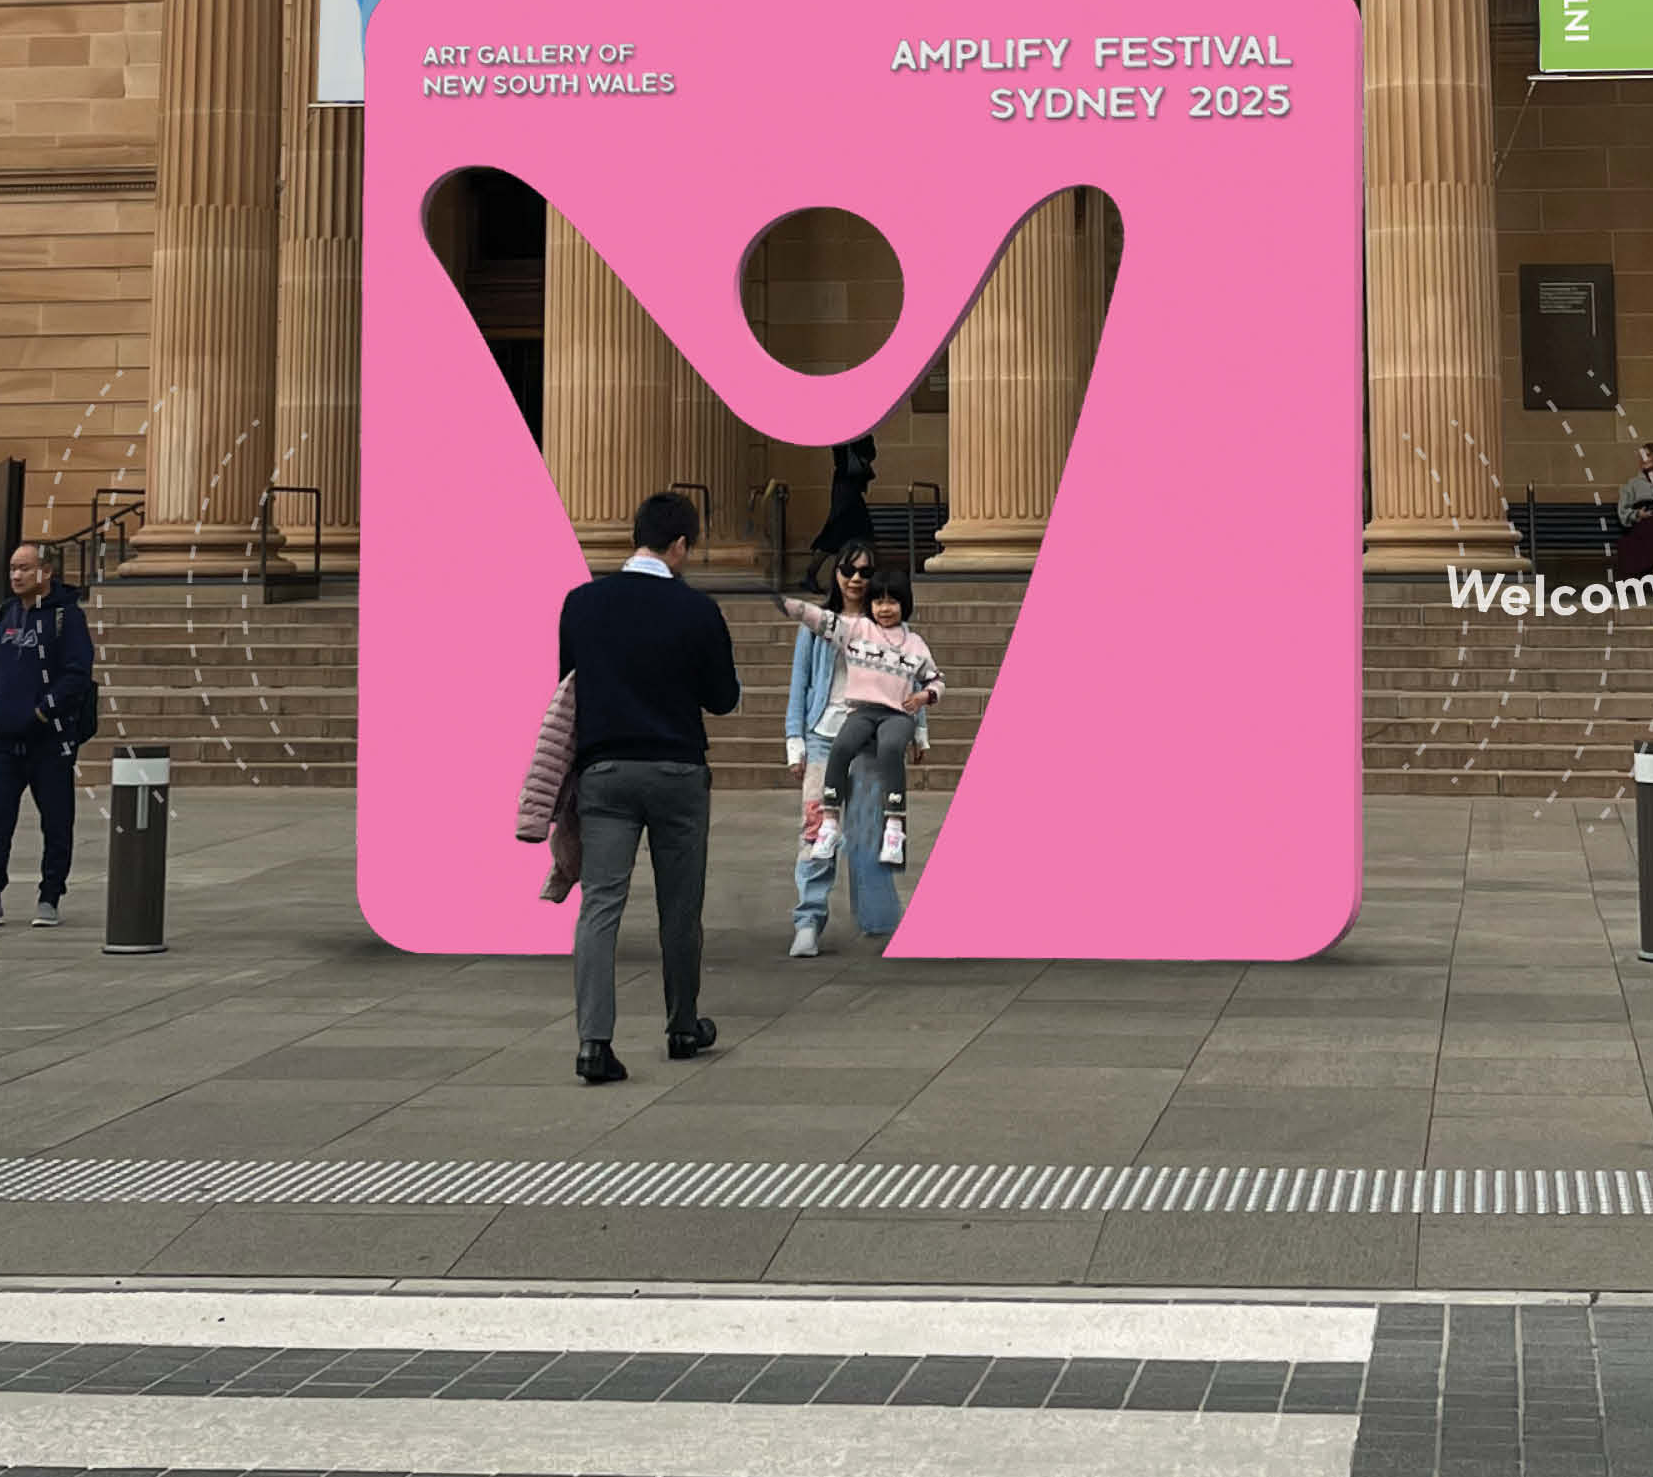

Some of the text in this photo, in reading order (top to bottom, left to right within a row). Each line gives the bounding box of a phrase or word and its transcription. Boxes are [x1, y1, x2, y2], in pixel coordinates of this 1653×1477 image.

[423, 43, 635, 66] ART GALLERY OF
[891, 35, 1293, 71] AMPLIFY FESTIVAL
[423, 72, 675, 96] NEW SOUTH WALES
[991, 84, 1292, 119] SYDNEY 2025
